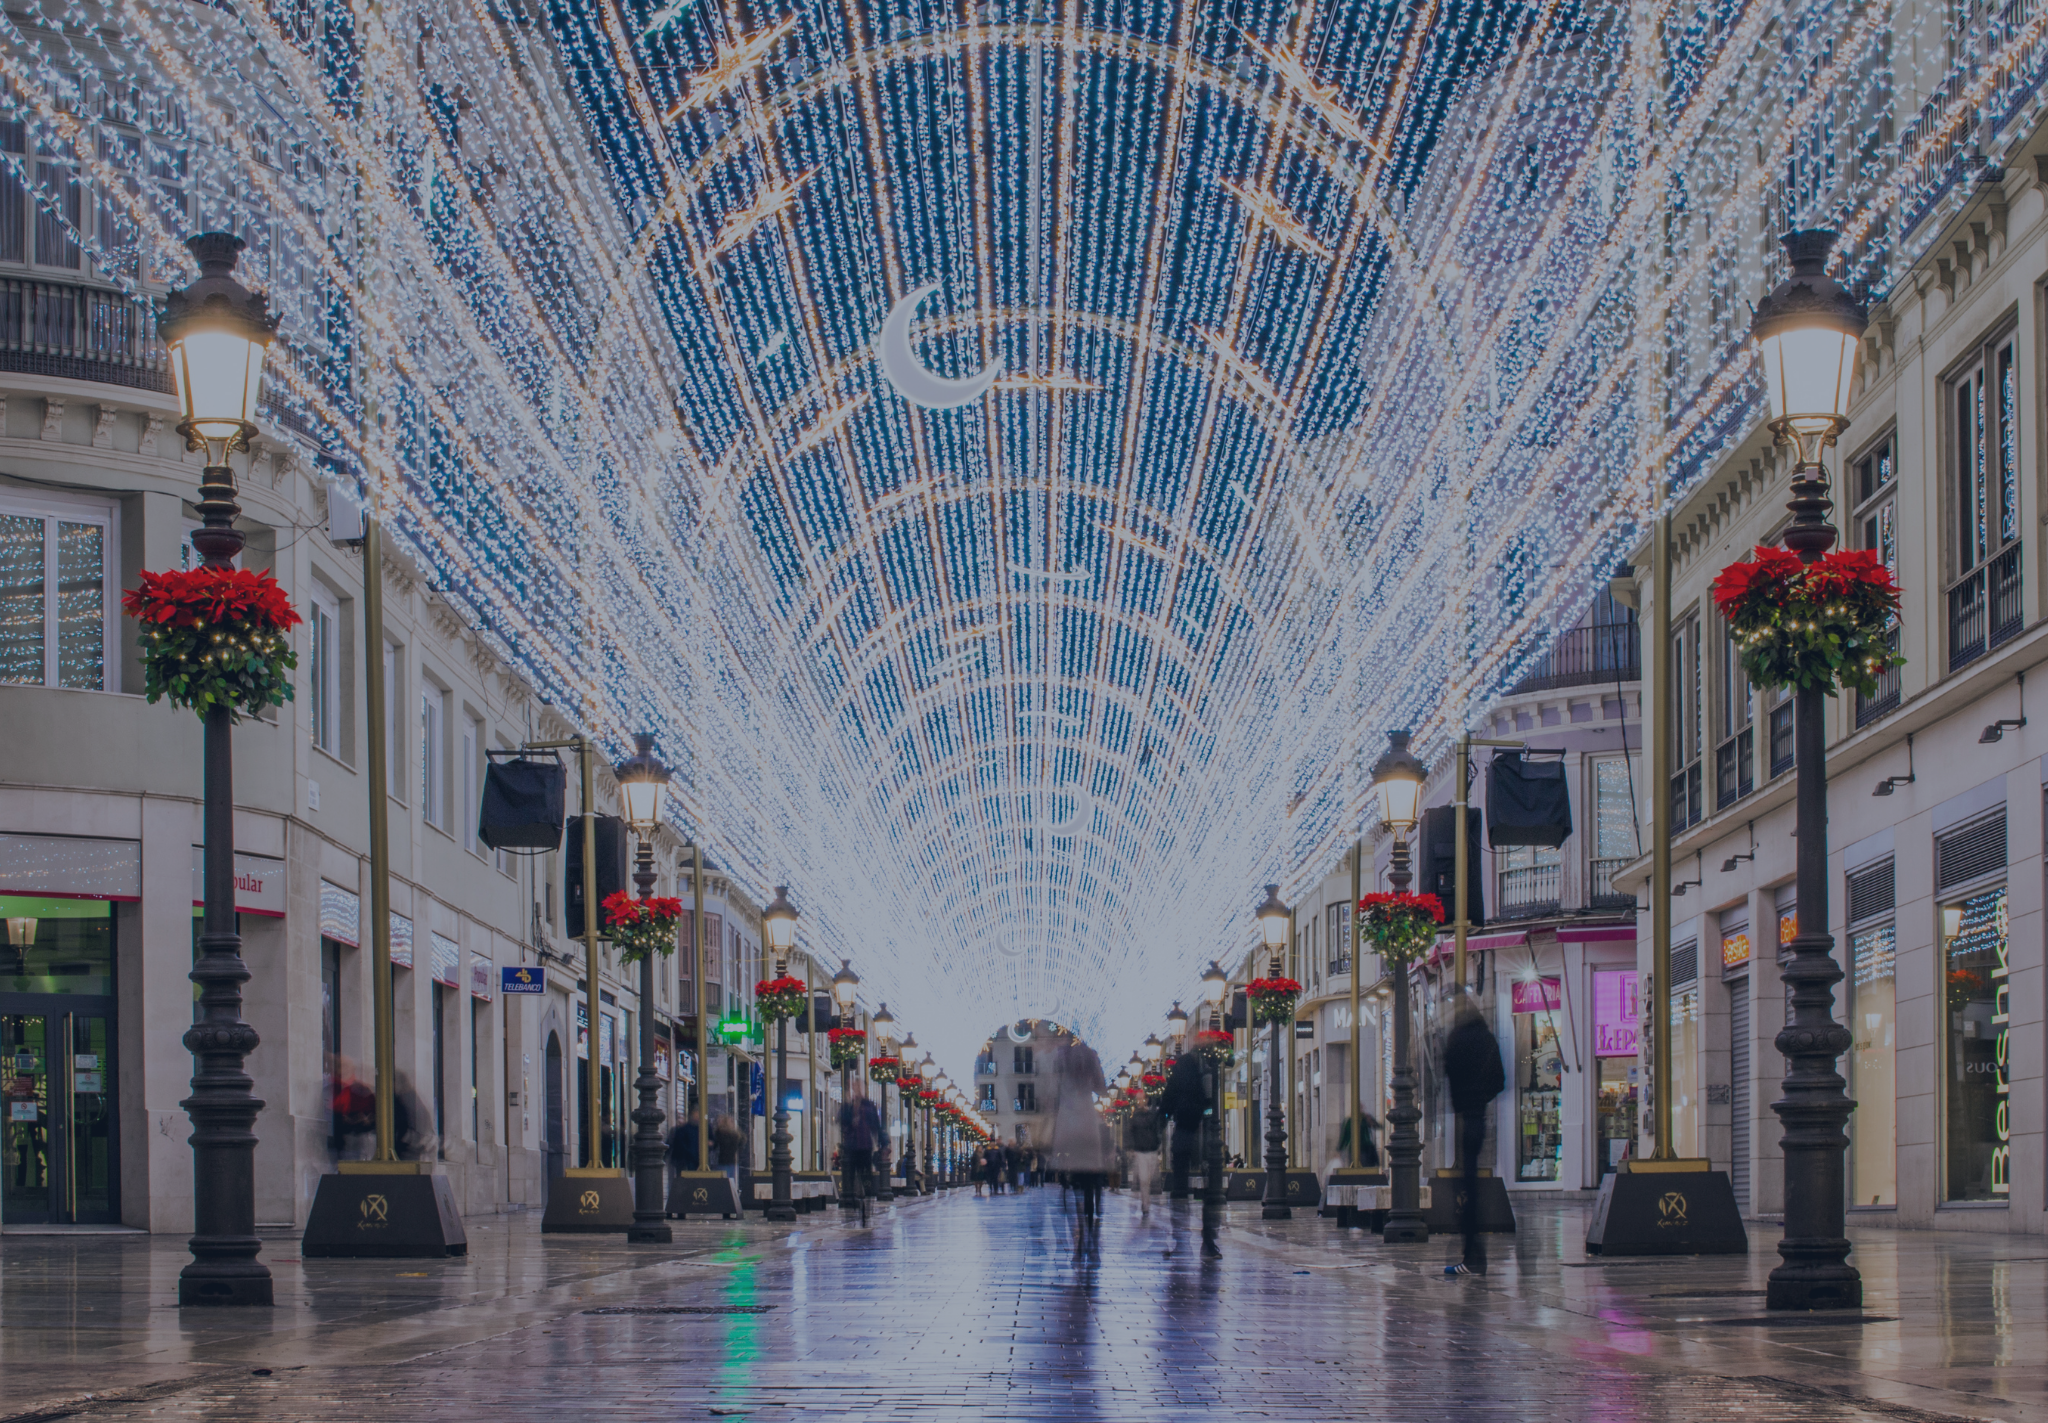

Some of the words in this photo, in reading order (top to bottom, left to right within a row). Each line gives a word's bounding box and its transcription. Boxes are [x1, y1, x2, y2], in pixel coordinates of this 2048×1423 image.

[504, 983, 542, 992] TELEBANCO
[1514, 984, 1561, 1005] CAFETERIA
[1991, 896, 2010, 1194] Bershka
